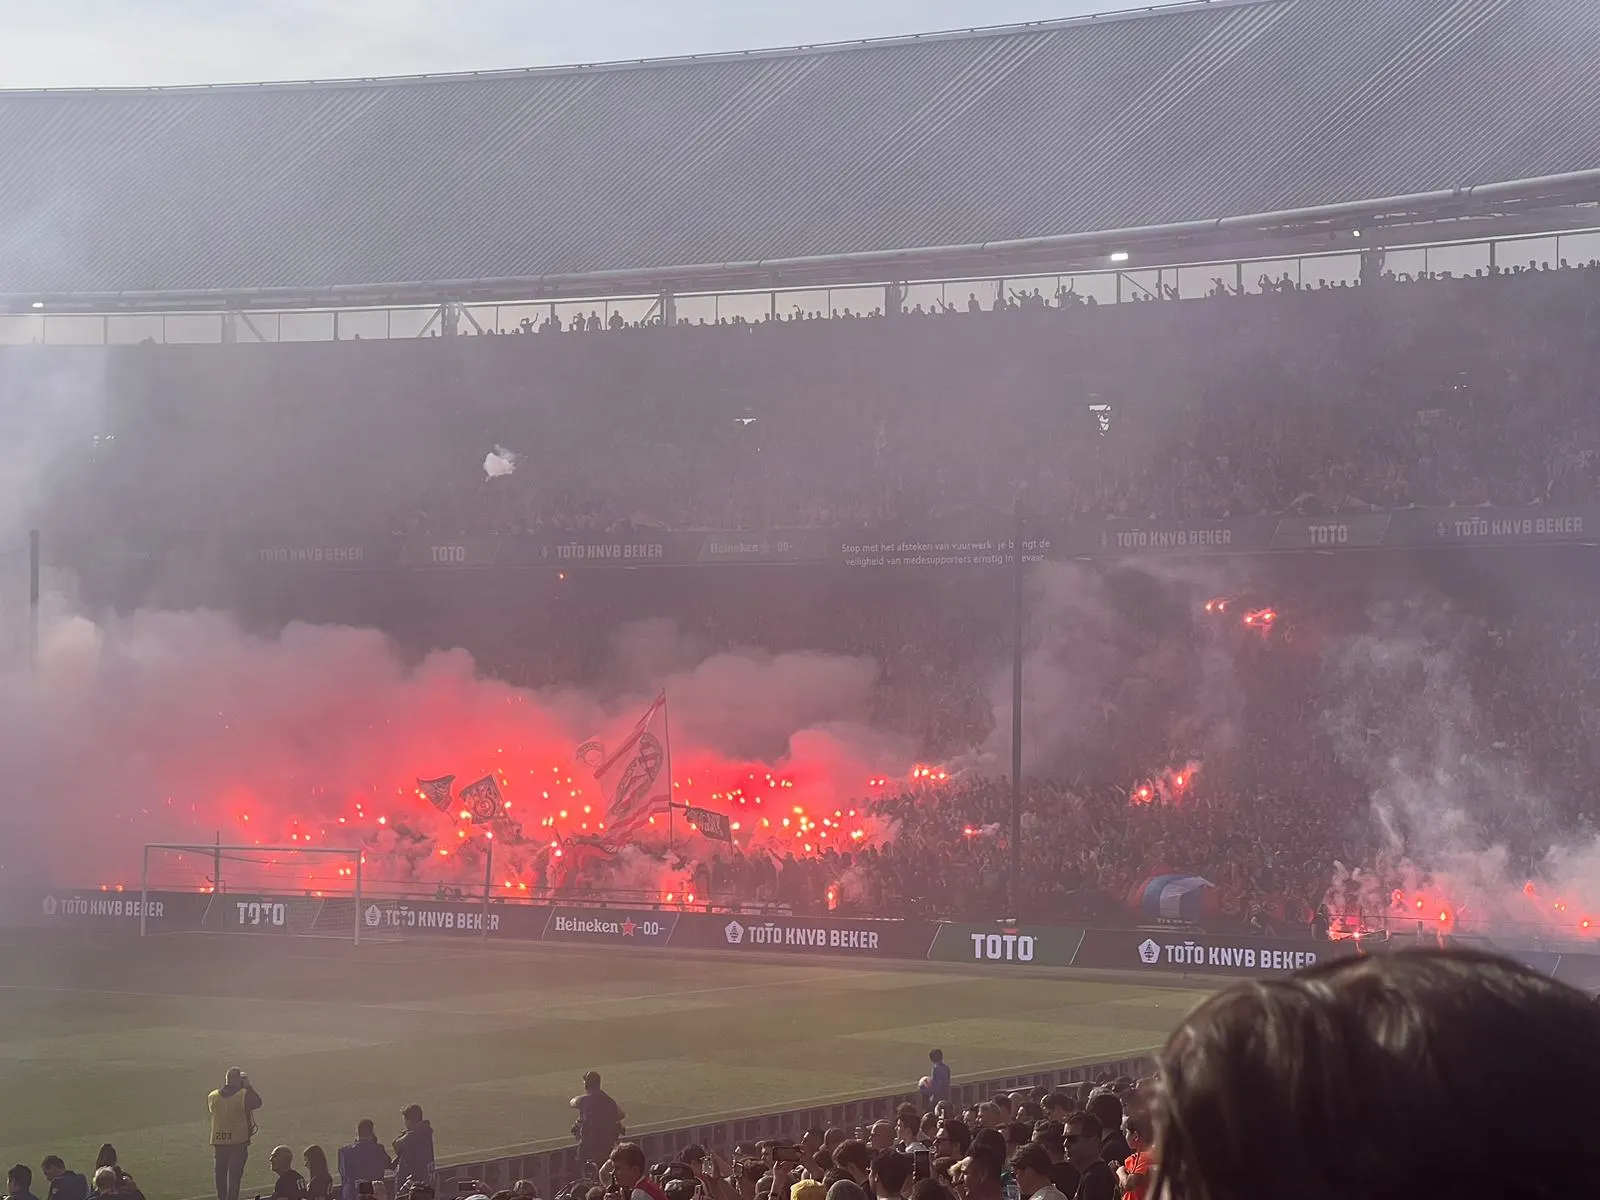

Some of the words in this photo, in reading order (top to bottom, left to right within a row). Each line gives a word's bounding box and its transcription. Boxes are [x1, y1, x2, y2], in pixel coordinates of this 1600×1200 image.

[1308, 523, 1349, 544] TOTO
[1455, 517, 1488, 536] TOTO
[1493, 519, 1532, 536] KNVB
[1536, 517, 1583, 534] BEKER
[841, 543, 861, 554] Stop
[862, 543, 879, 553] met
[880, 543, 896, 552] het
[897, 542, 933, 552] afsteken
[934, 543, 950, 551] van
[997, 542, 1006, 551] je
[1008, 540, 1037, 550] bngt
[1039, 539, 1051, 548] de
[1116, 528, 1145, 547] TOTO
[1149, 531, 1186, 547] KNVB
[1189, 529, 1232, 546] BEKER
[431, 543, 466, 563] TOTO
[556, 541, 585, 559] TOTO
[588, 544, 622, 559] KNVB
[624, 543, 664, 558] BEKER
[710, 541, 760, 554] Heineken
[886, 556, 902, 566] van
[1020, 554, 1045, 562] evaar
[60, 896, 87, 914] TOTO
[89, 899, 122, 916] KNVB
[236, 902, 286, 926] TOTO
[418, 909, 454, 928] KNVB
[555, 916, 620, 934] Heineken
[748, 923, 782, 944] TOTO
[785, 927, 826, 946] KNVB
[830, 930, 879, 949] BEKER
[972, 933, 1034, 961] TOTO
[1165, 941, 1205, 965] TOTO
[1208, 948, 1254, 968] KNVB
[1260, 950, 1317, 971] BEKER
